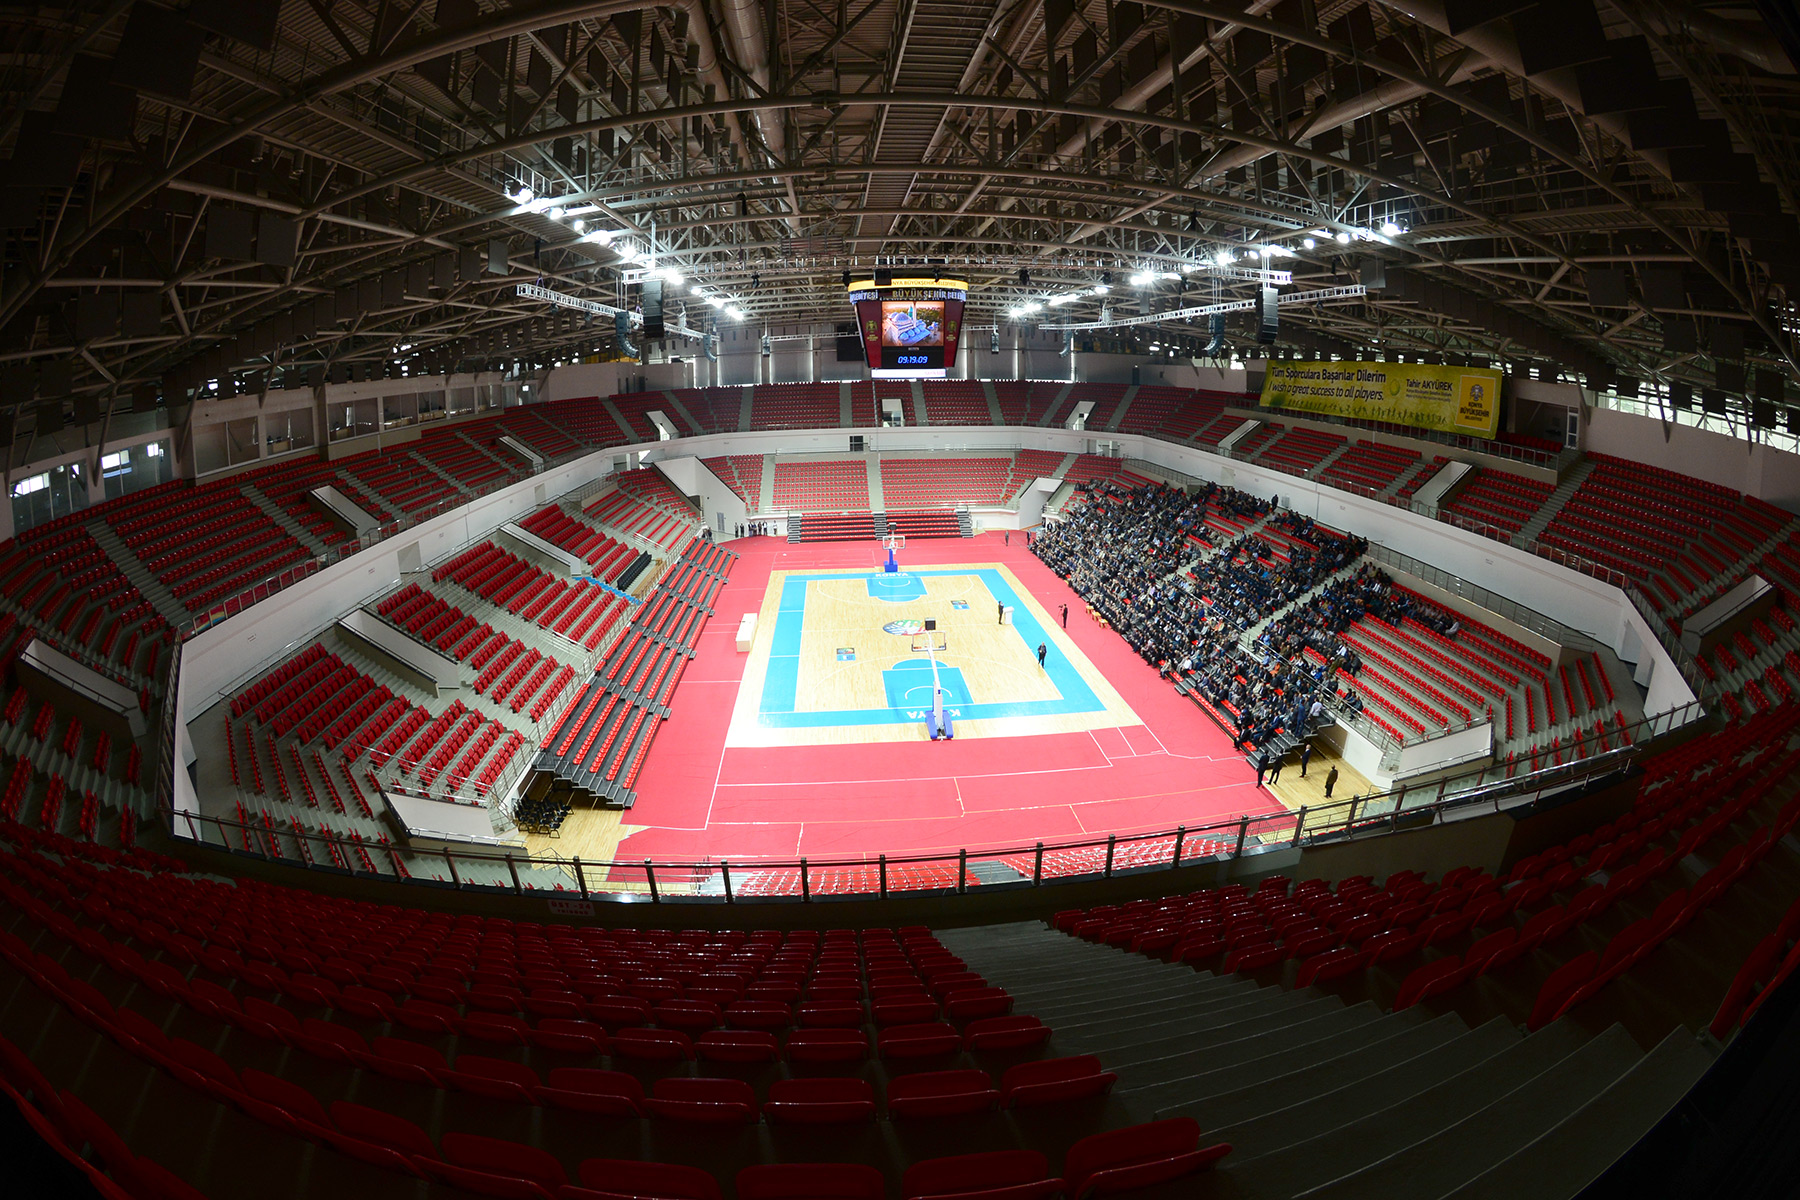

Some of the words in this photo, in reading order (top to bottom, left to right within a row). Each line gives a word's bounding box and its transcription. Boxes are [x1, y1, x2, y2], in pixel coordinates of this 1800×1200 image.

[1272, 366, 1285, 378] Tüm
[1286, 368, 1321, 380] Sporculara
[1321, 369, 1355, 384] Başarılar
[1356, 369, 1387, 383] Dilerim
[1272, 382, 1287, 392] wish
[1291, 384, 1309, 396] great
[1309, 387, 1335, 397] success
[1335, 387, 1344, 397] to
[1344, 386, 1354, 398] all
[1354, 387, 1384, 402] players.
[1406, 378, 1421, 388] Tahir
[1422, 379, 1453, 391] AKYÜREK
[906, 709, 961, 719] KYA
